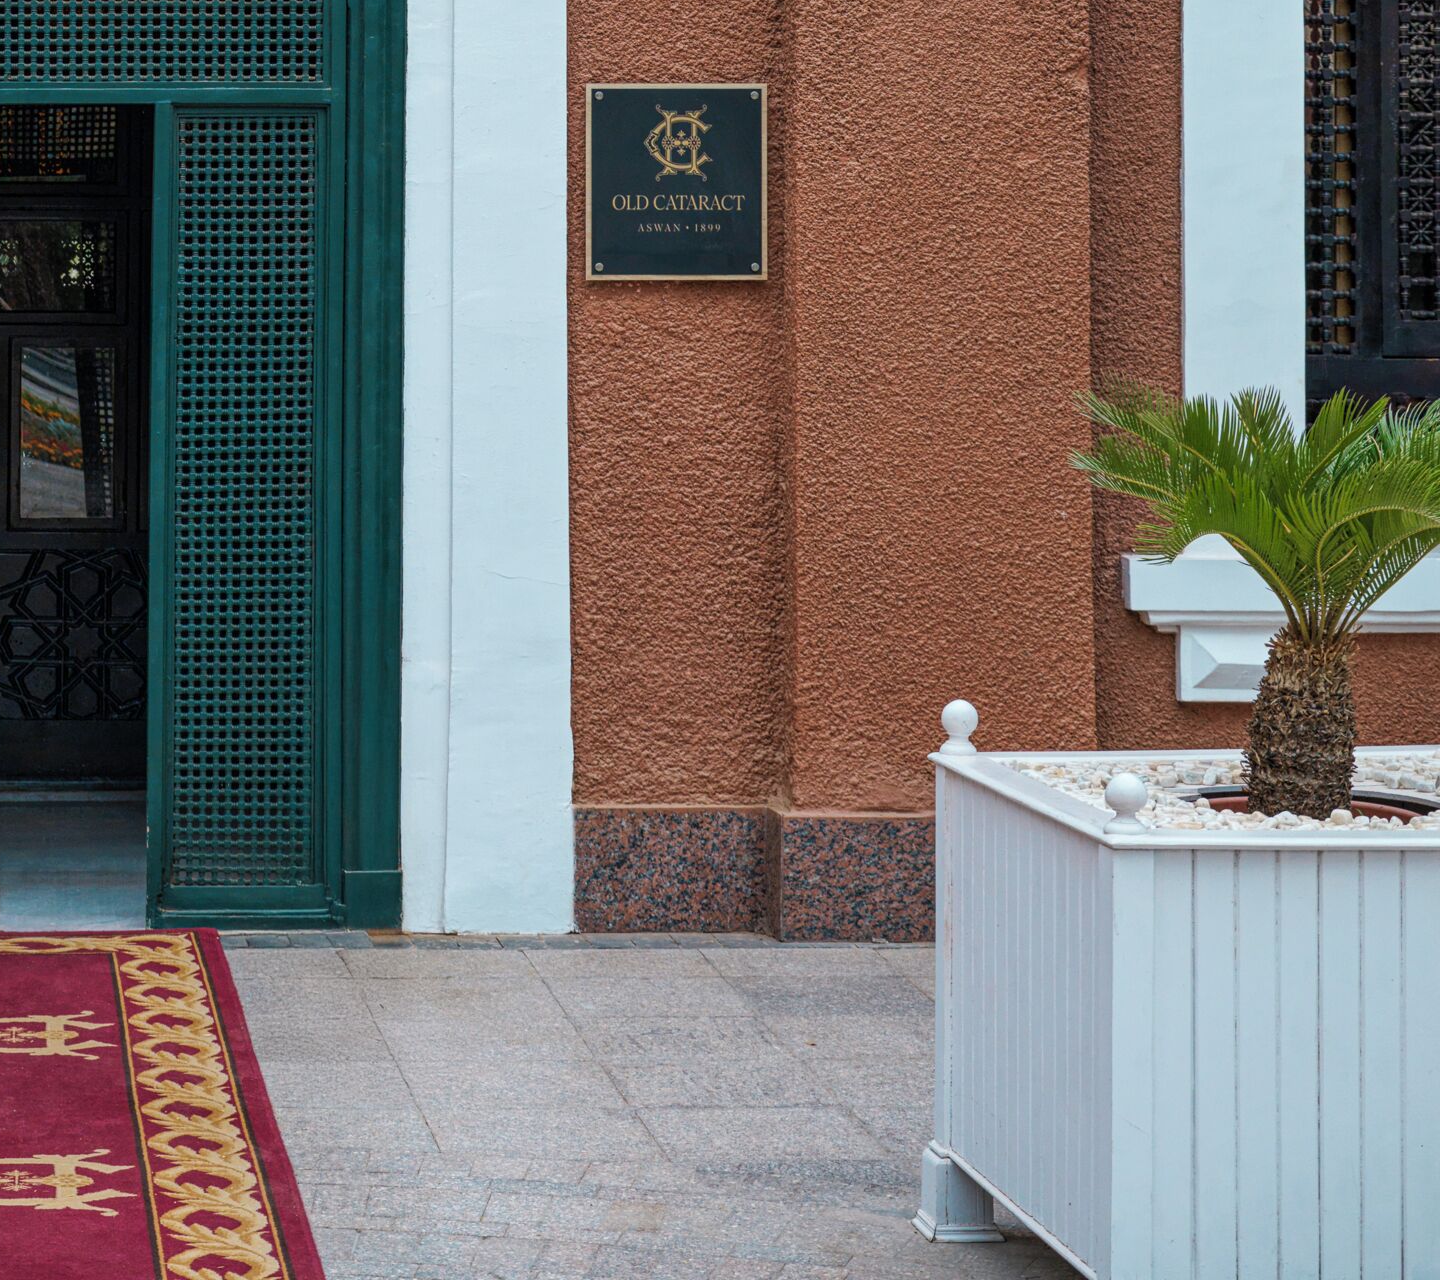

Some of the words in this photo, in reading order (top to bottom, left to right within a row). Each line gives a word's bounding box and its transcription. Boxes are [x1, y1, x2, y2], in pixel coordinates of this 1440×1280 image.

[612, 195, 649, 211] OLD
[653, 195, 746, 211] CATARACT
[637, 224, 681, 233] ASWAN
[694, 224, 721, 233] 1899
